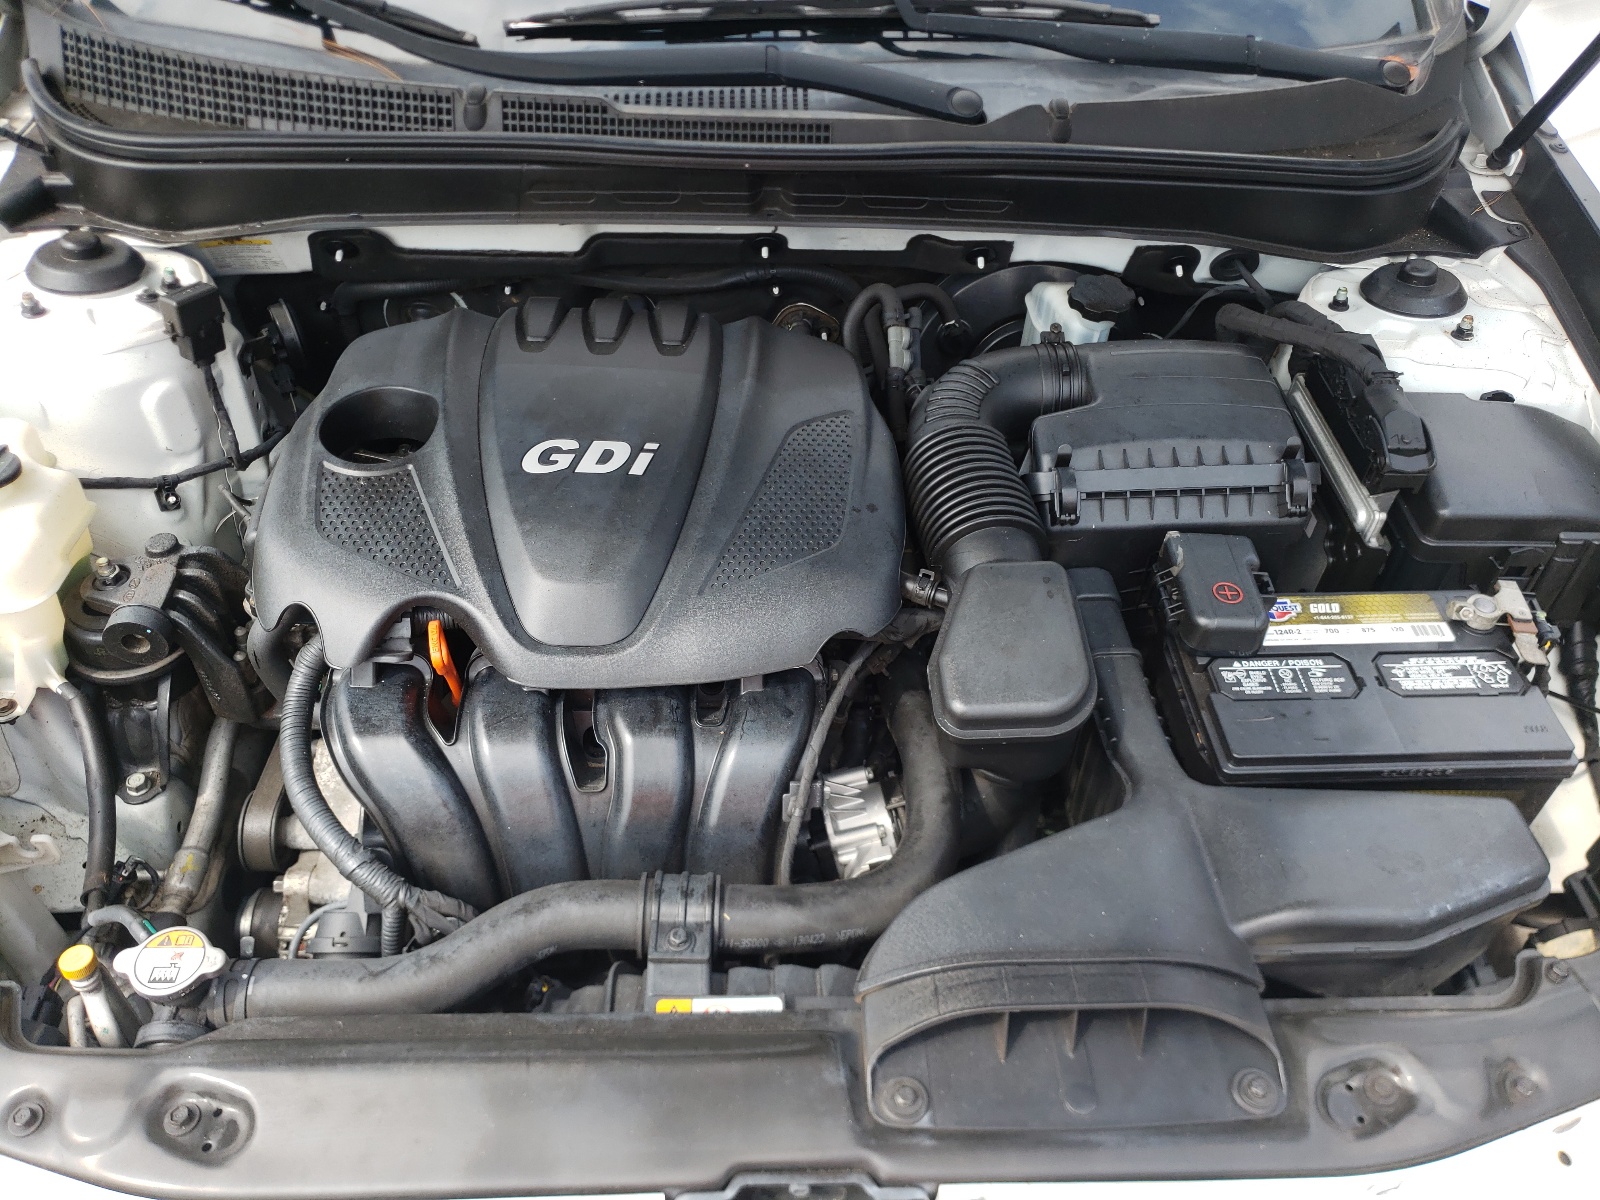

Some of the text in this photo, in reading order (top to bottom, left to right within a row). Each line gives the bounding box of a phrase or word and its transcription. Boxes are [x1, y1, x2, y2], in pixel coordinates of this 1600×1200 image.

[521, 438, 660, 476] GDi
[1309, 603, 1340, 614] GOLD
[1242, 659, 1280, 668] DANGER
[1288, 658, 1324, 667] POISON
